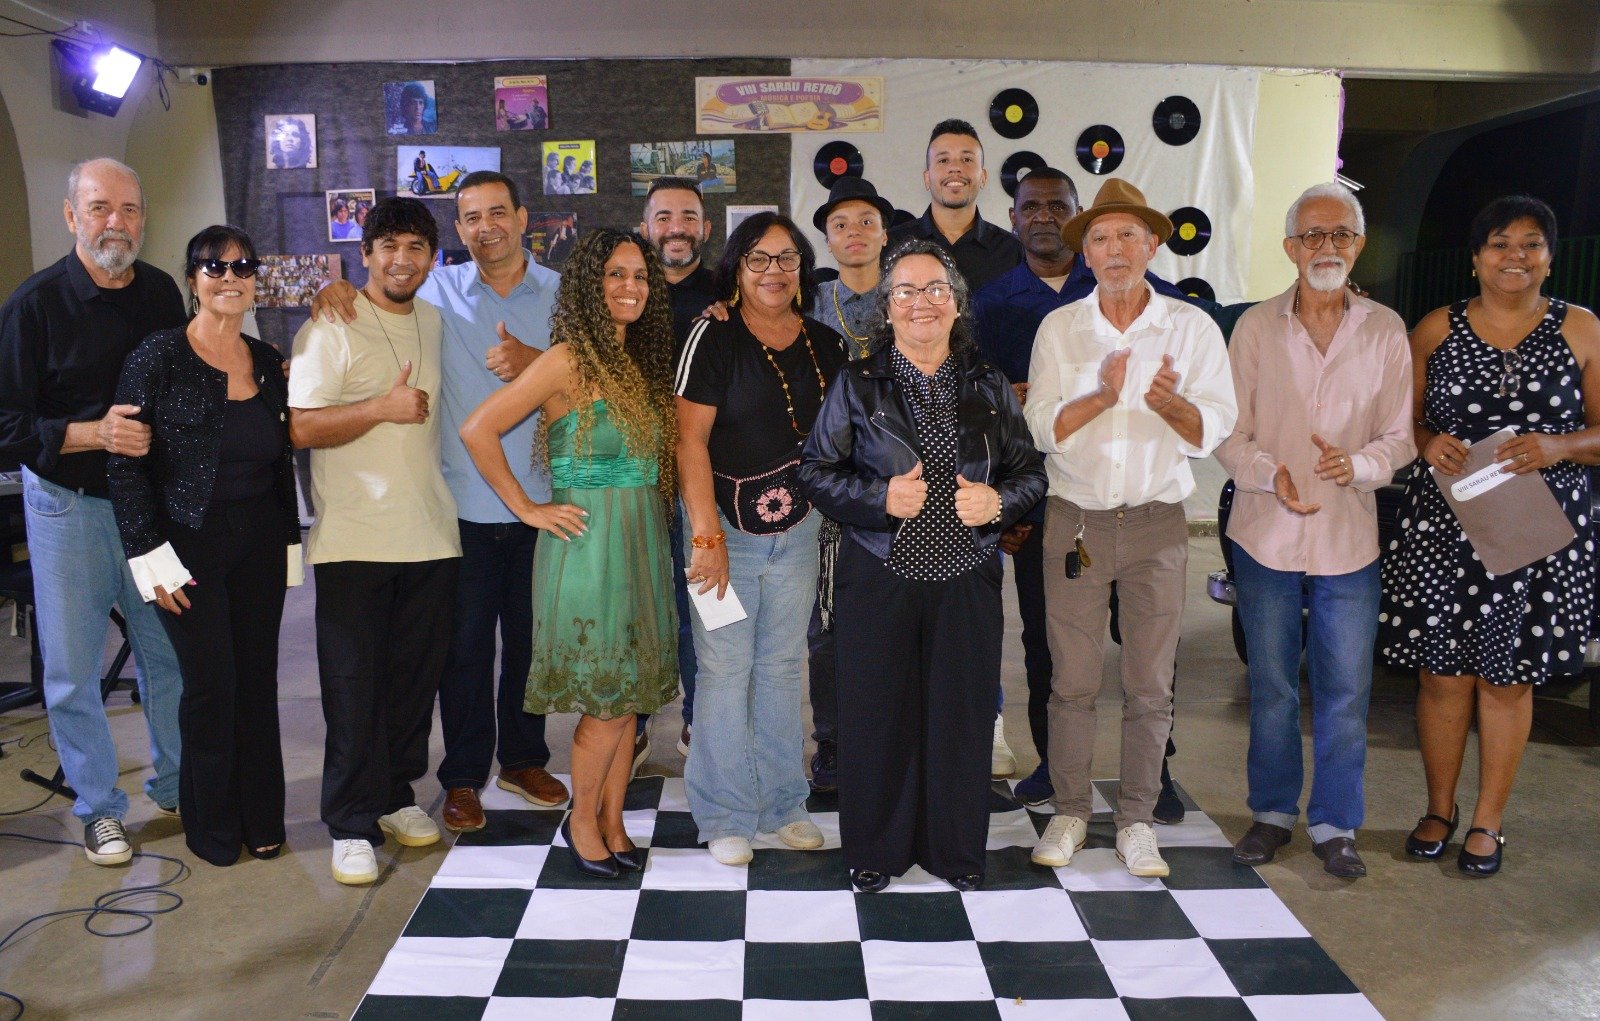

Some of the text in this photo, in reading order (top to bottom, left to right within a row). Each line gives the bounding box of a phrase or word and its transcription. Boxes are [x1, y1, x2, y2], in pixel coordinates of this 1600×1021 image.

[735, 82, 843, 96] VIII SARAU RETRÔ
[1468, 475, 1490, 488] SARAU
